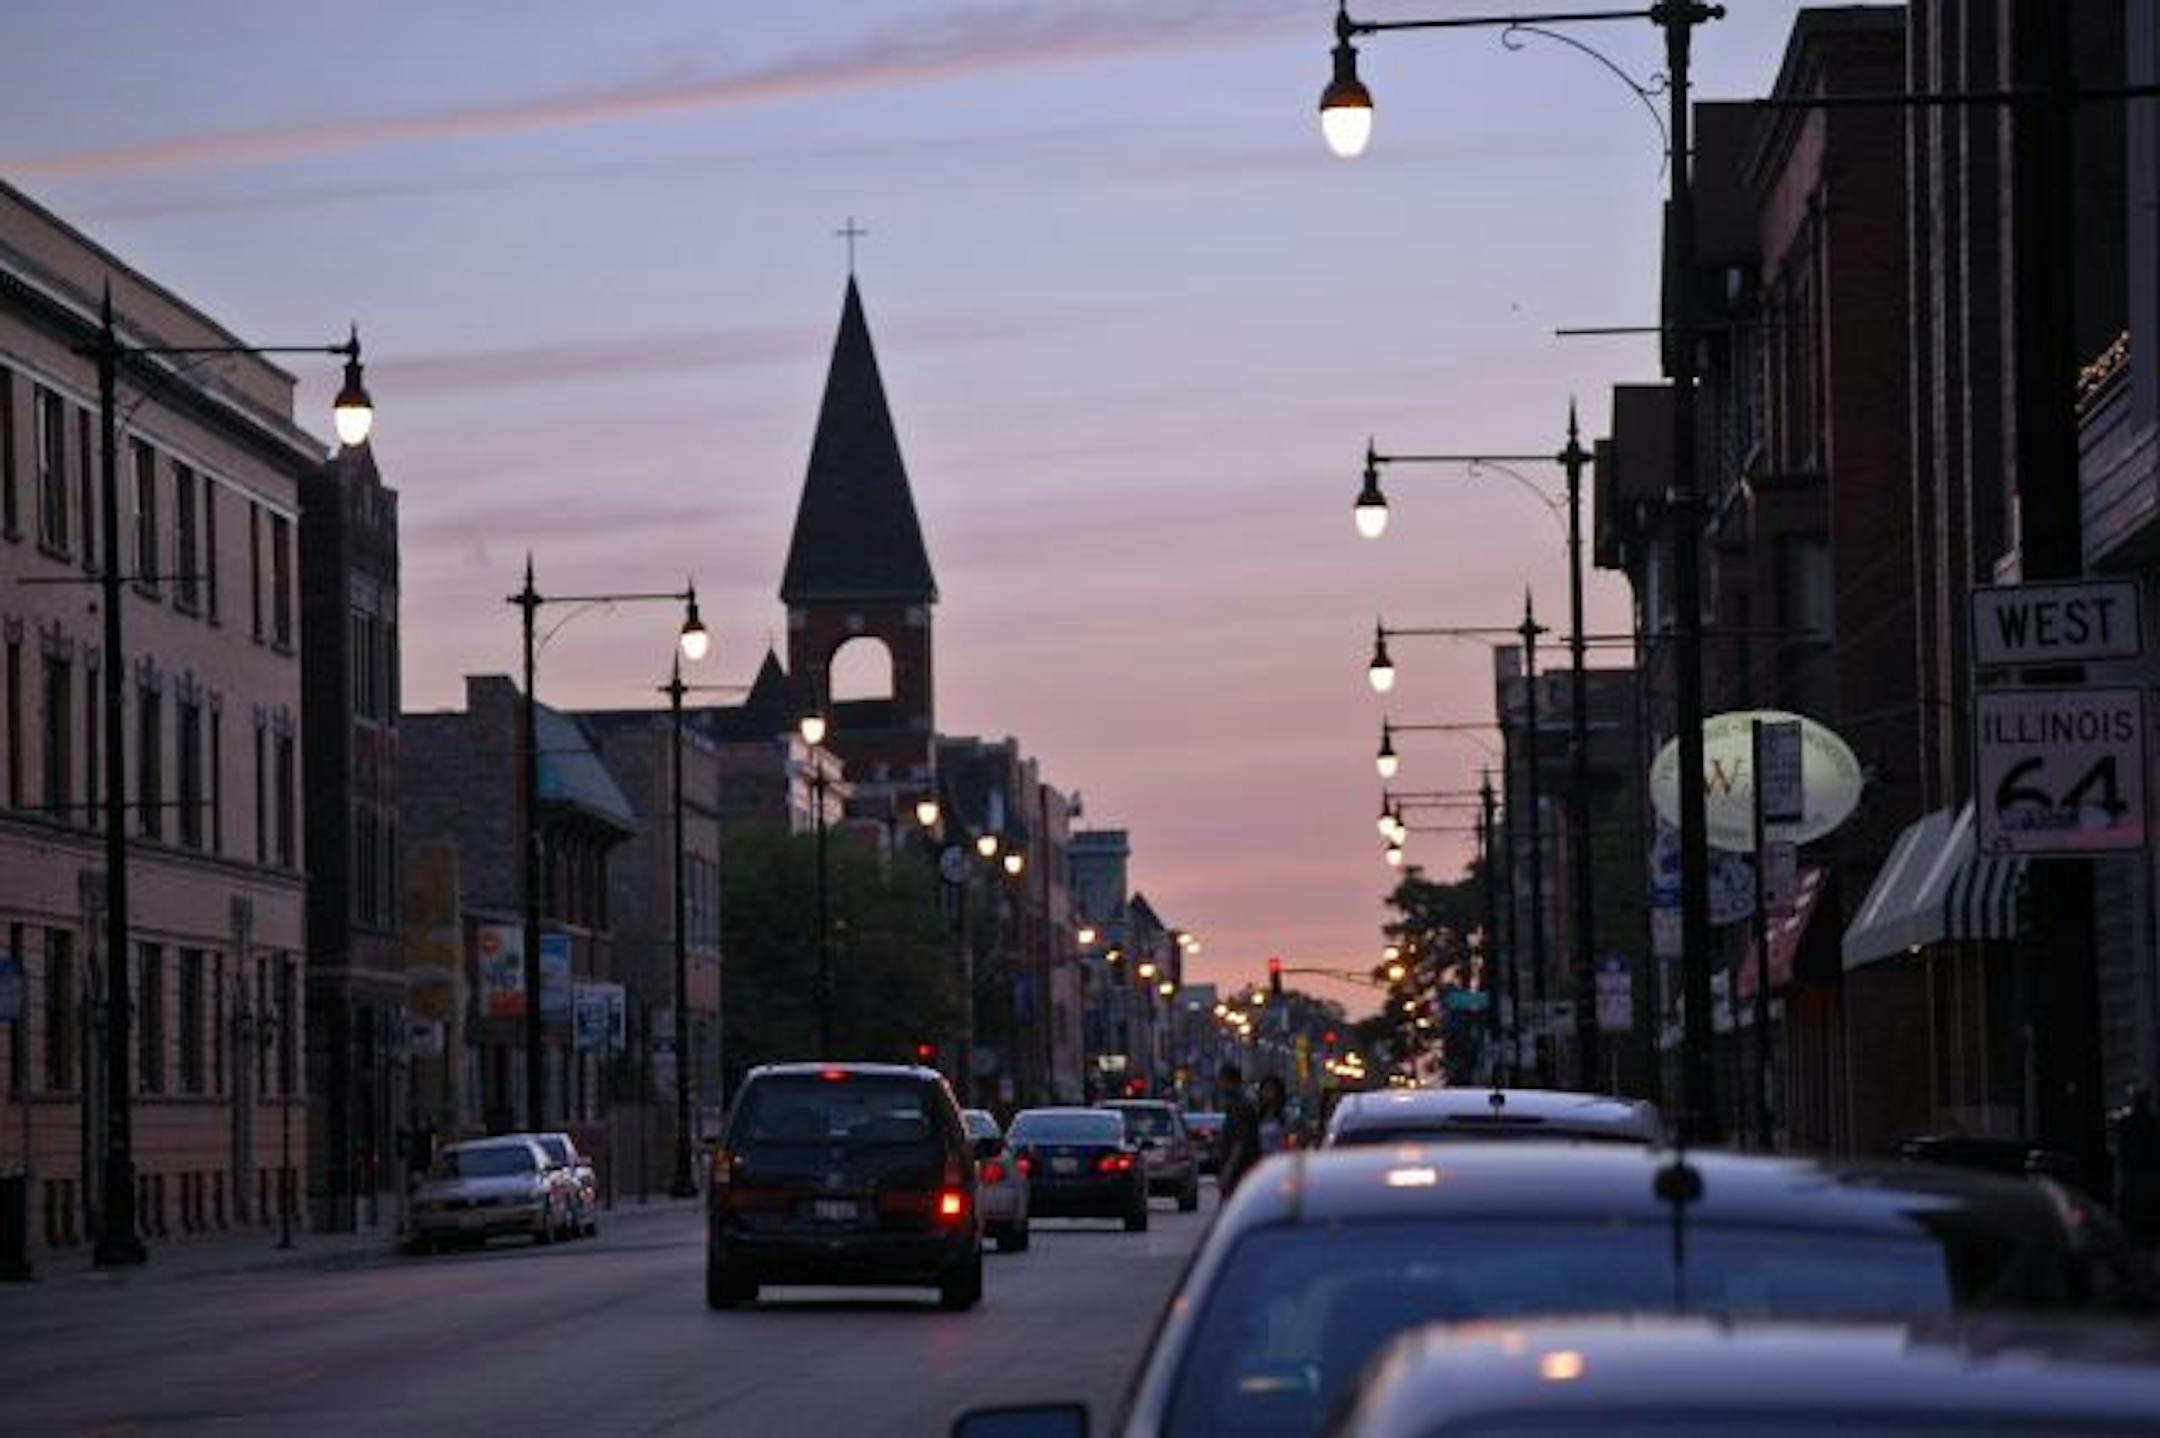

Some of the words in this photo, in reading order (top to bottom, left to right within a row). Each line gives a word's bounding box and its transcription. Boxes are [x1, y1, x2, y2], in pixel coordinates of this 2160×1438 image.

[1998, 599, 2115, 648] WEST
[1985, 711, 2134, 743] ILLINOIS
[1996, 756, 2127, 829] 64
